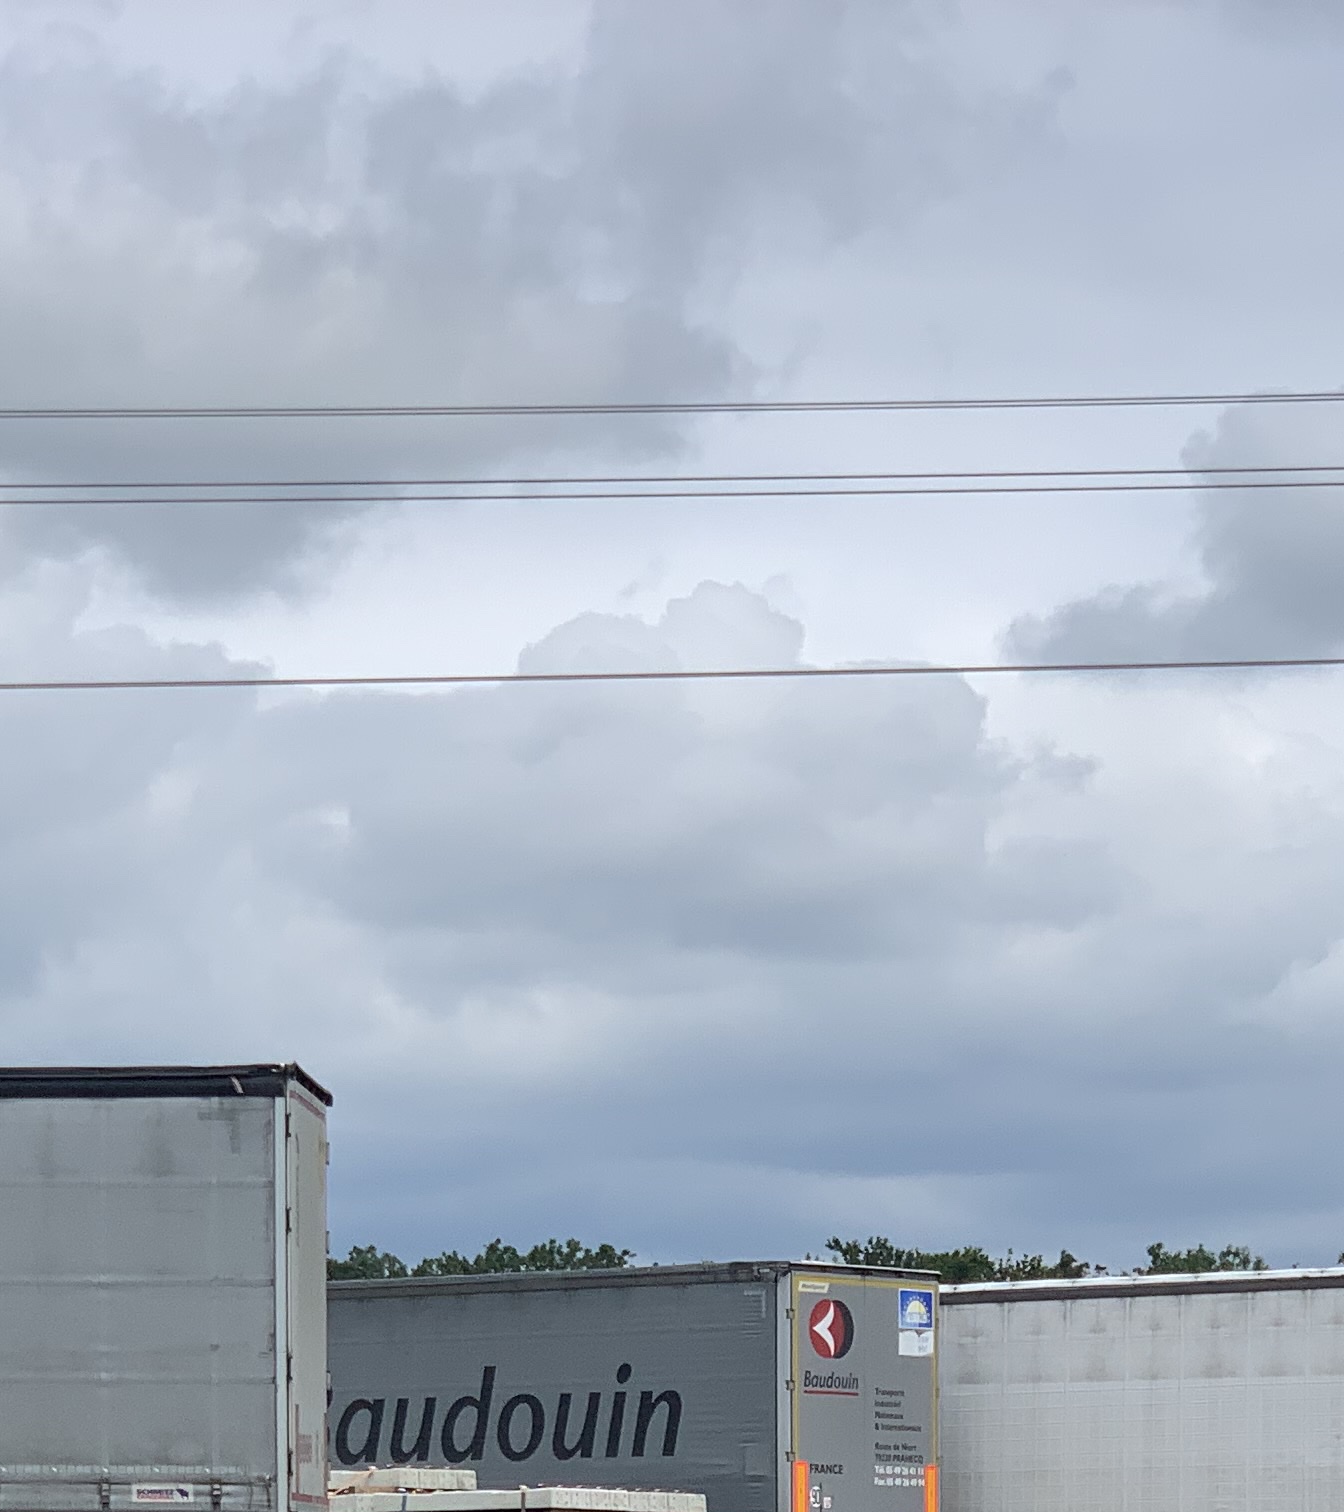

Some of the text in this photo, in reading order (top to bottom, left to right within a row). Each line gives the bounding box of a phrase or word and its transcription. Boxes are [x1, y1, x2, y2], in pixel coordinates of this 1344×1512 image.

[803, 1370, 859, 1390] Baudouin
[327, 1362, 683, 1466] audouin
[809, 1463, 844, 1475] FRANCE
